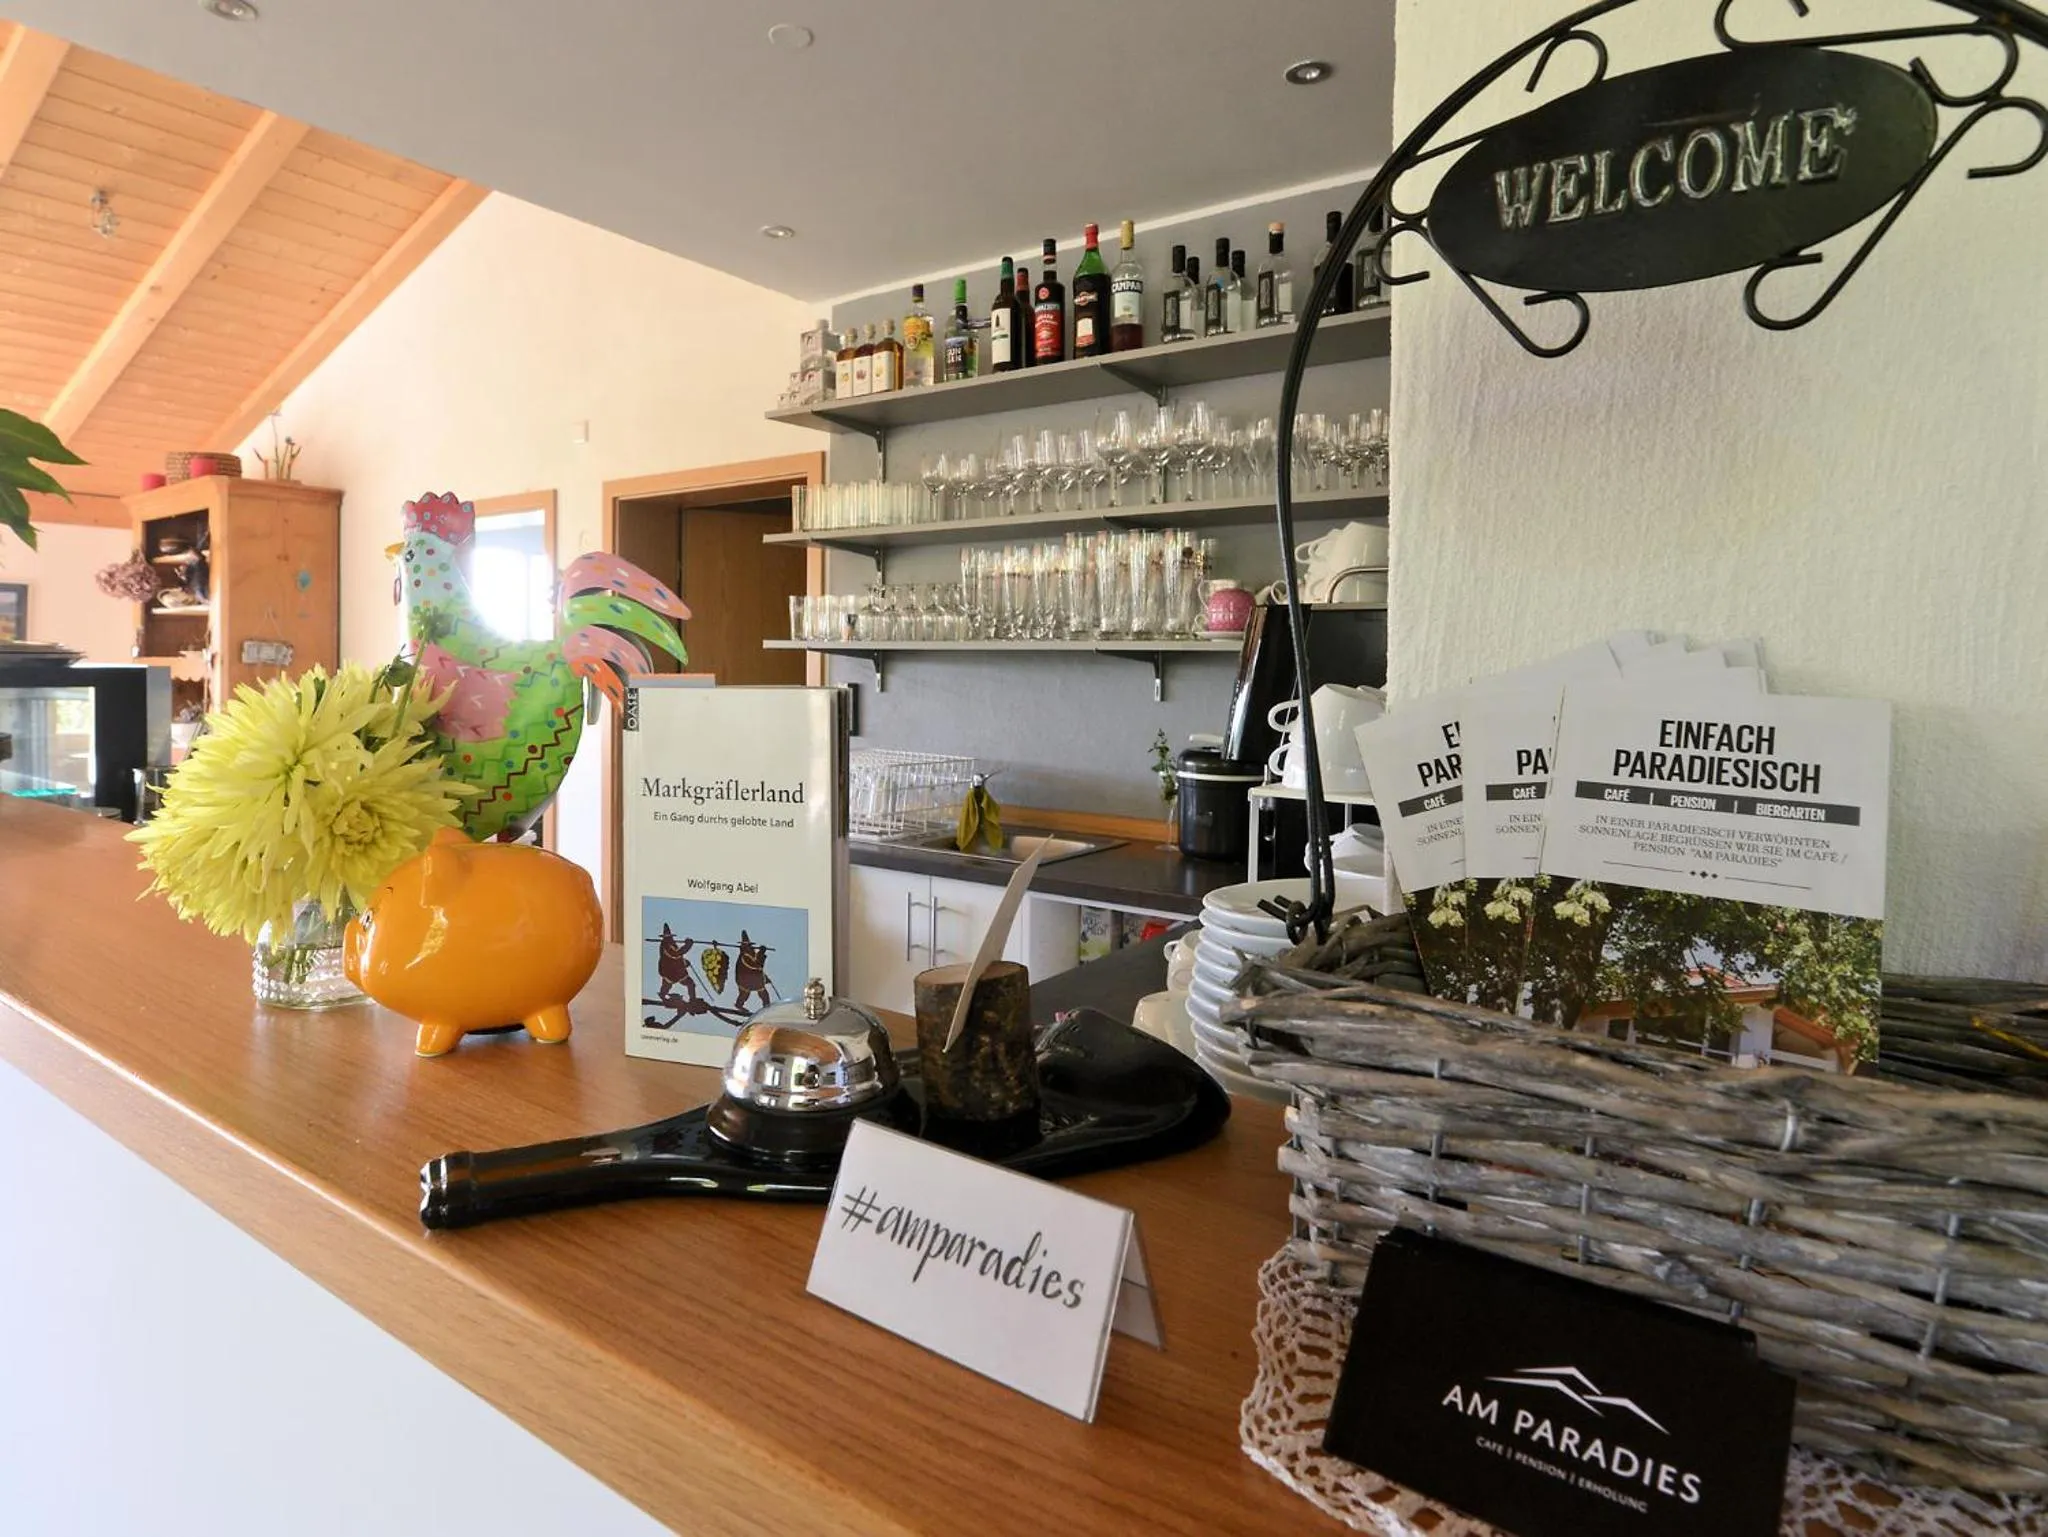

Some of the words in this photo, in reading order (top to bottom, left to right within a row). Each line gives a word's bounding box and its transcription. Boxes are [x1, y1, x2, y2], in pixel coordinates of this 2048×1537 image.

[1494, 103, 1857, 231] WELCOME
[1659, 719, 1776, 755] EINFACH
[1417, 753, 1463, 787] PAR
[1516, 746, 1552, 776] PA
[1613, 749, 1821, 794] PARADIESISCH
[642, 777, 805, 805] Markgräflerland
[1513, 785, 1537, 800] CAFÉ
[1604, 788, 1631, 802] CAFÉ
[1670, 795, 1717, 811] PENSION
[1755, 802, 1826, 821] BIERGARTEN
[653, 812, 669, 821] Ein
[670, 812, 695, 825] Gang
[697, 813, 729, 825] durchs
[731, 815, 768, 828] gelobte
[770, 818, 795, 828] Land
[1508, 813, 1520, 823] IN
[1595, 814, 1609, 825] IN
[1610, 816, 1646, 829] EINER
[1647, 819, 1736, 838] PARADIESISCH
[1738, 829, 1832, 849] VERWÖHNTEN
[1579, 824, 1659, 842] SONNENLAGE
[1735, 841, 1759, 854] WIR
[1761, 844, 1783, 857] SIE
[1785, 847, 1801, 858] IM
[1633, 841, 1686, 857] PENSION
[687, 879, 734, 894] Wolfgang
[736, 882, 759, 894] Abel
[840, 1186, 1085, 1309] #amparadies
[1442, 1384, 1499, 1425] AM
[1513, 1409, 1701, 1503] PARADIES
[1514, 1451, 1568, 1481] PENSION
[1577, 1476, 1649, 1514] ERHOLUNG
